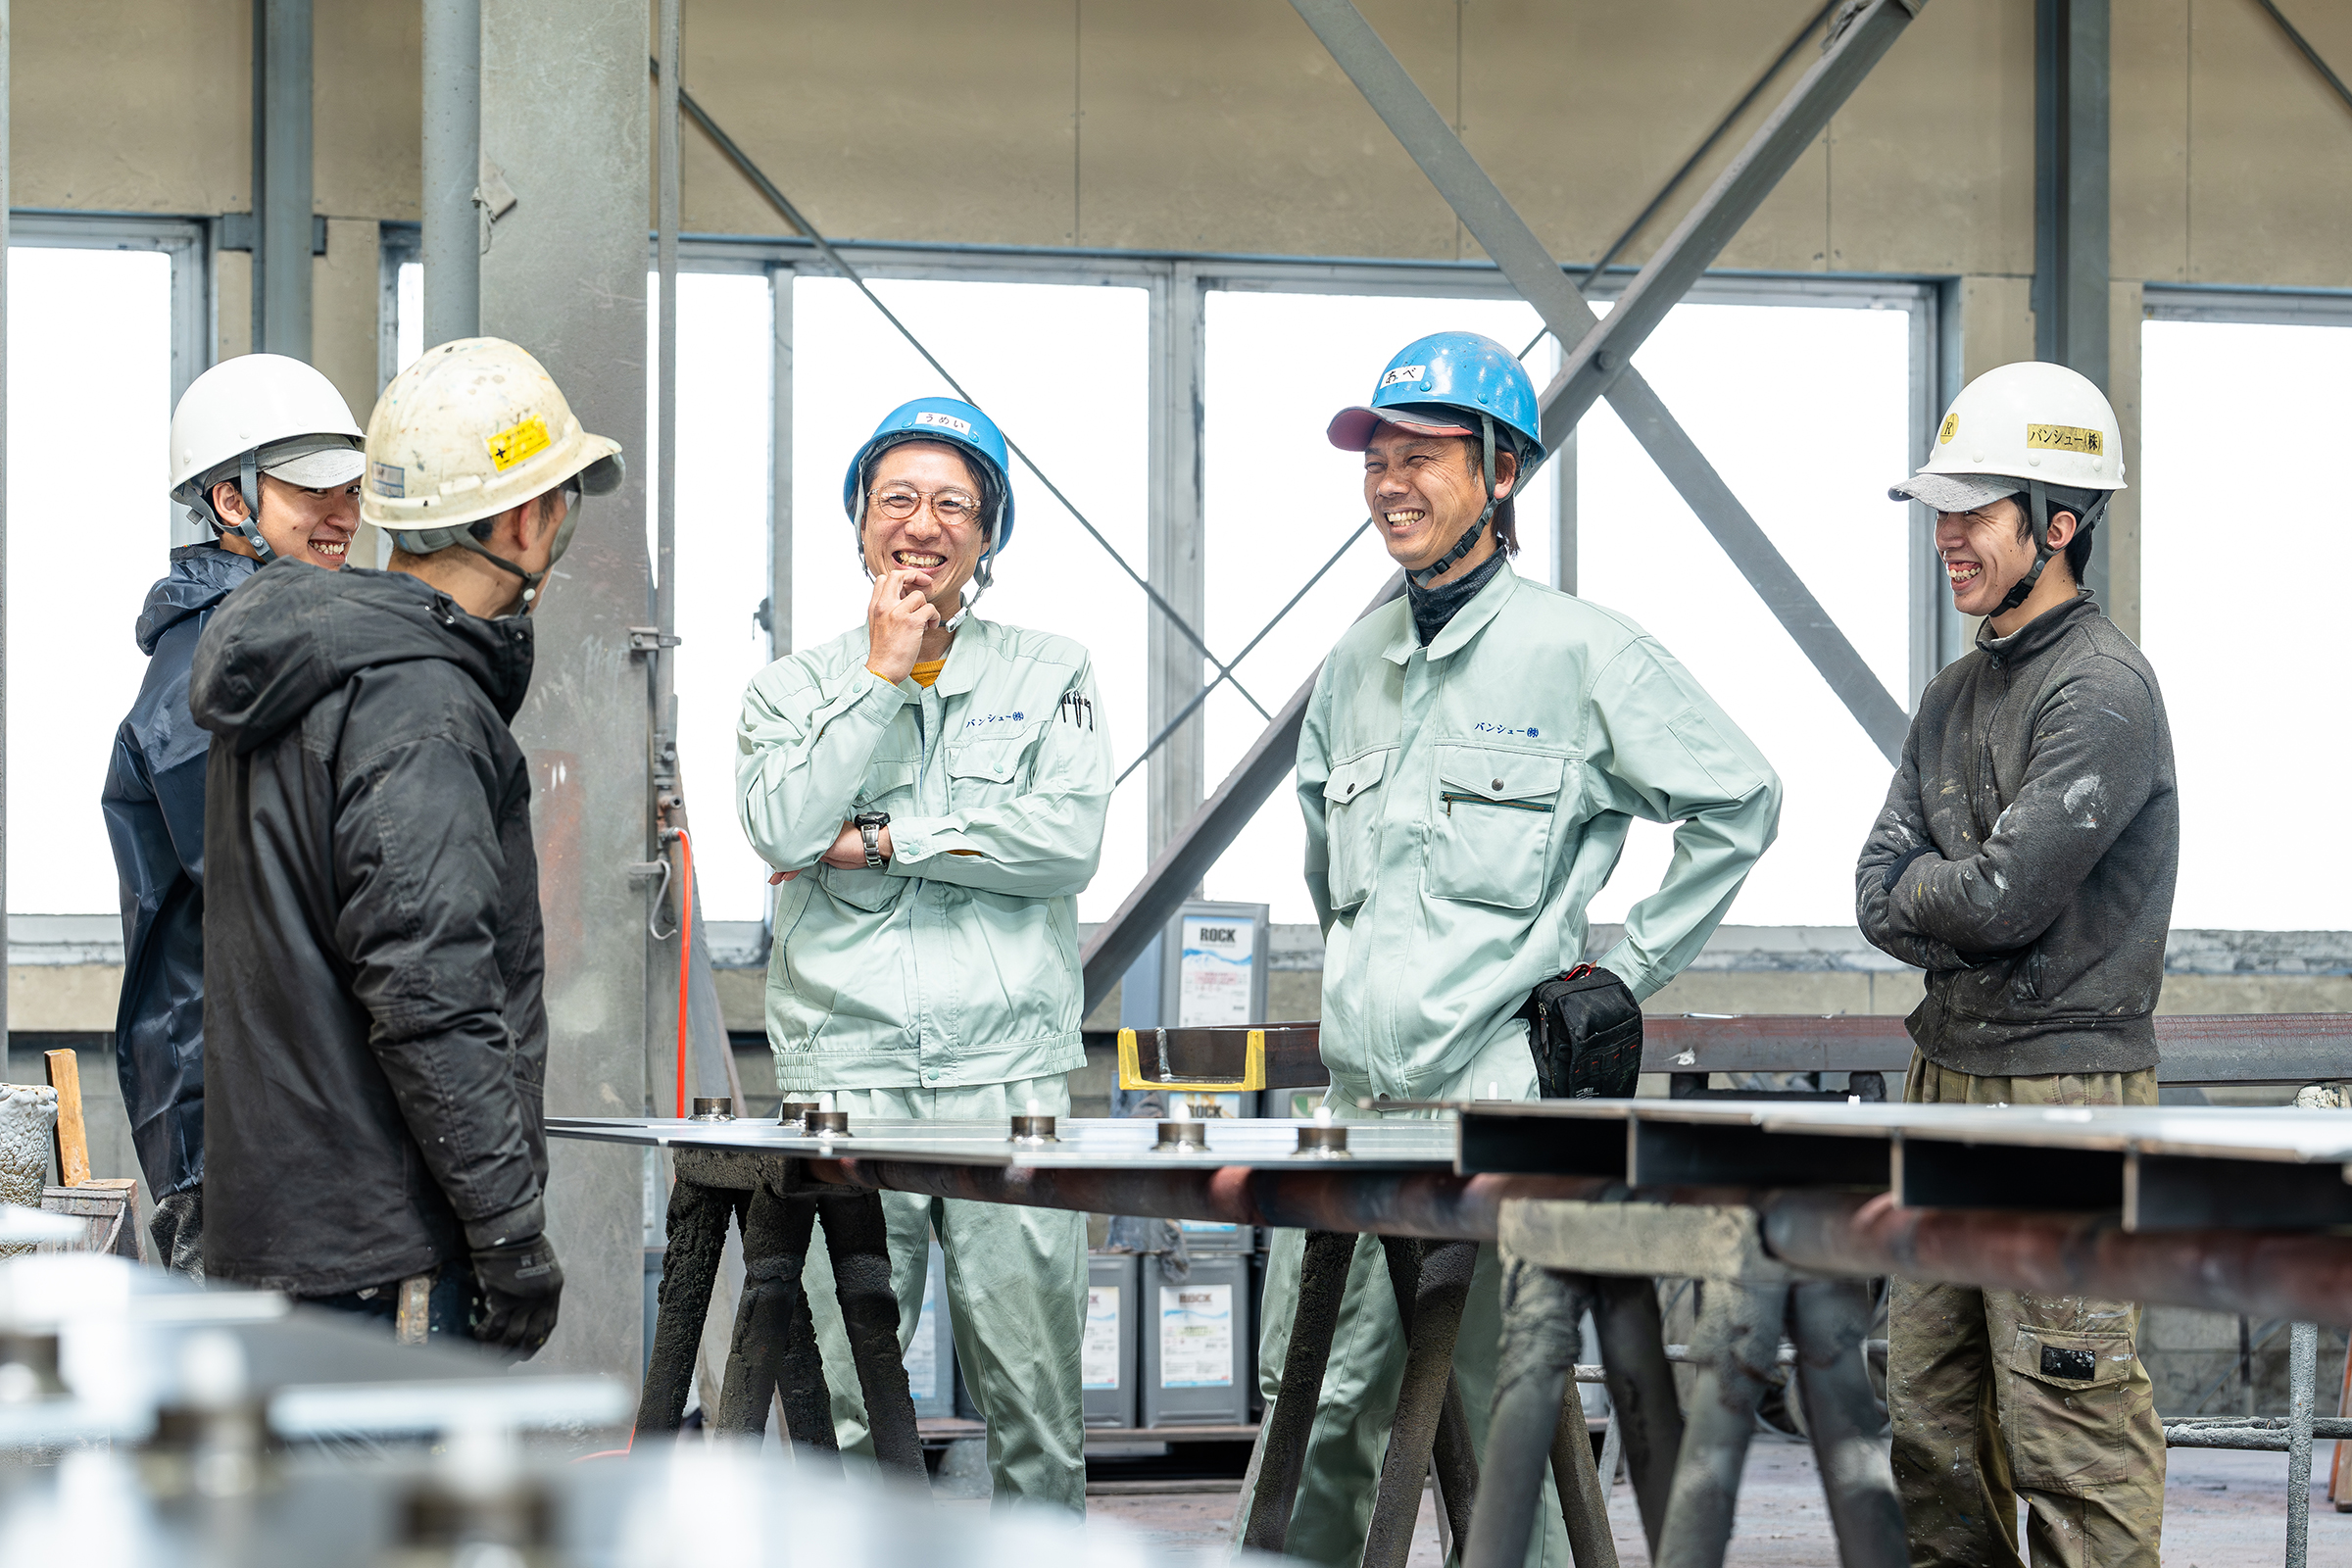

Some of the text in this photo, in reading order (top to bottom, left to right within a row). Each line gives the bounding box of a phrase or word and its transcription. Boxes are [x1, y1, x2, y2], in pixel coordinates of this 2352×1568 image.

[1385, 367, 1416, 384] あべ
[925, 413, 964, 428] うめい
[1943, 421, 1953, 435] R
[1200, 927, 1237, 943] ROCK
